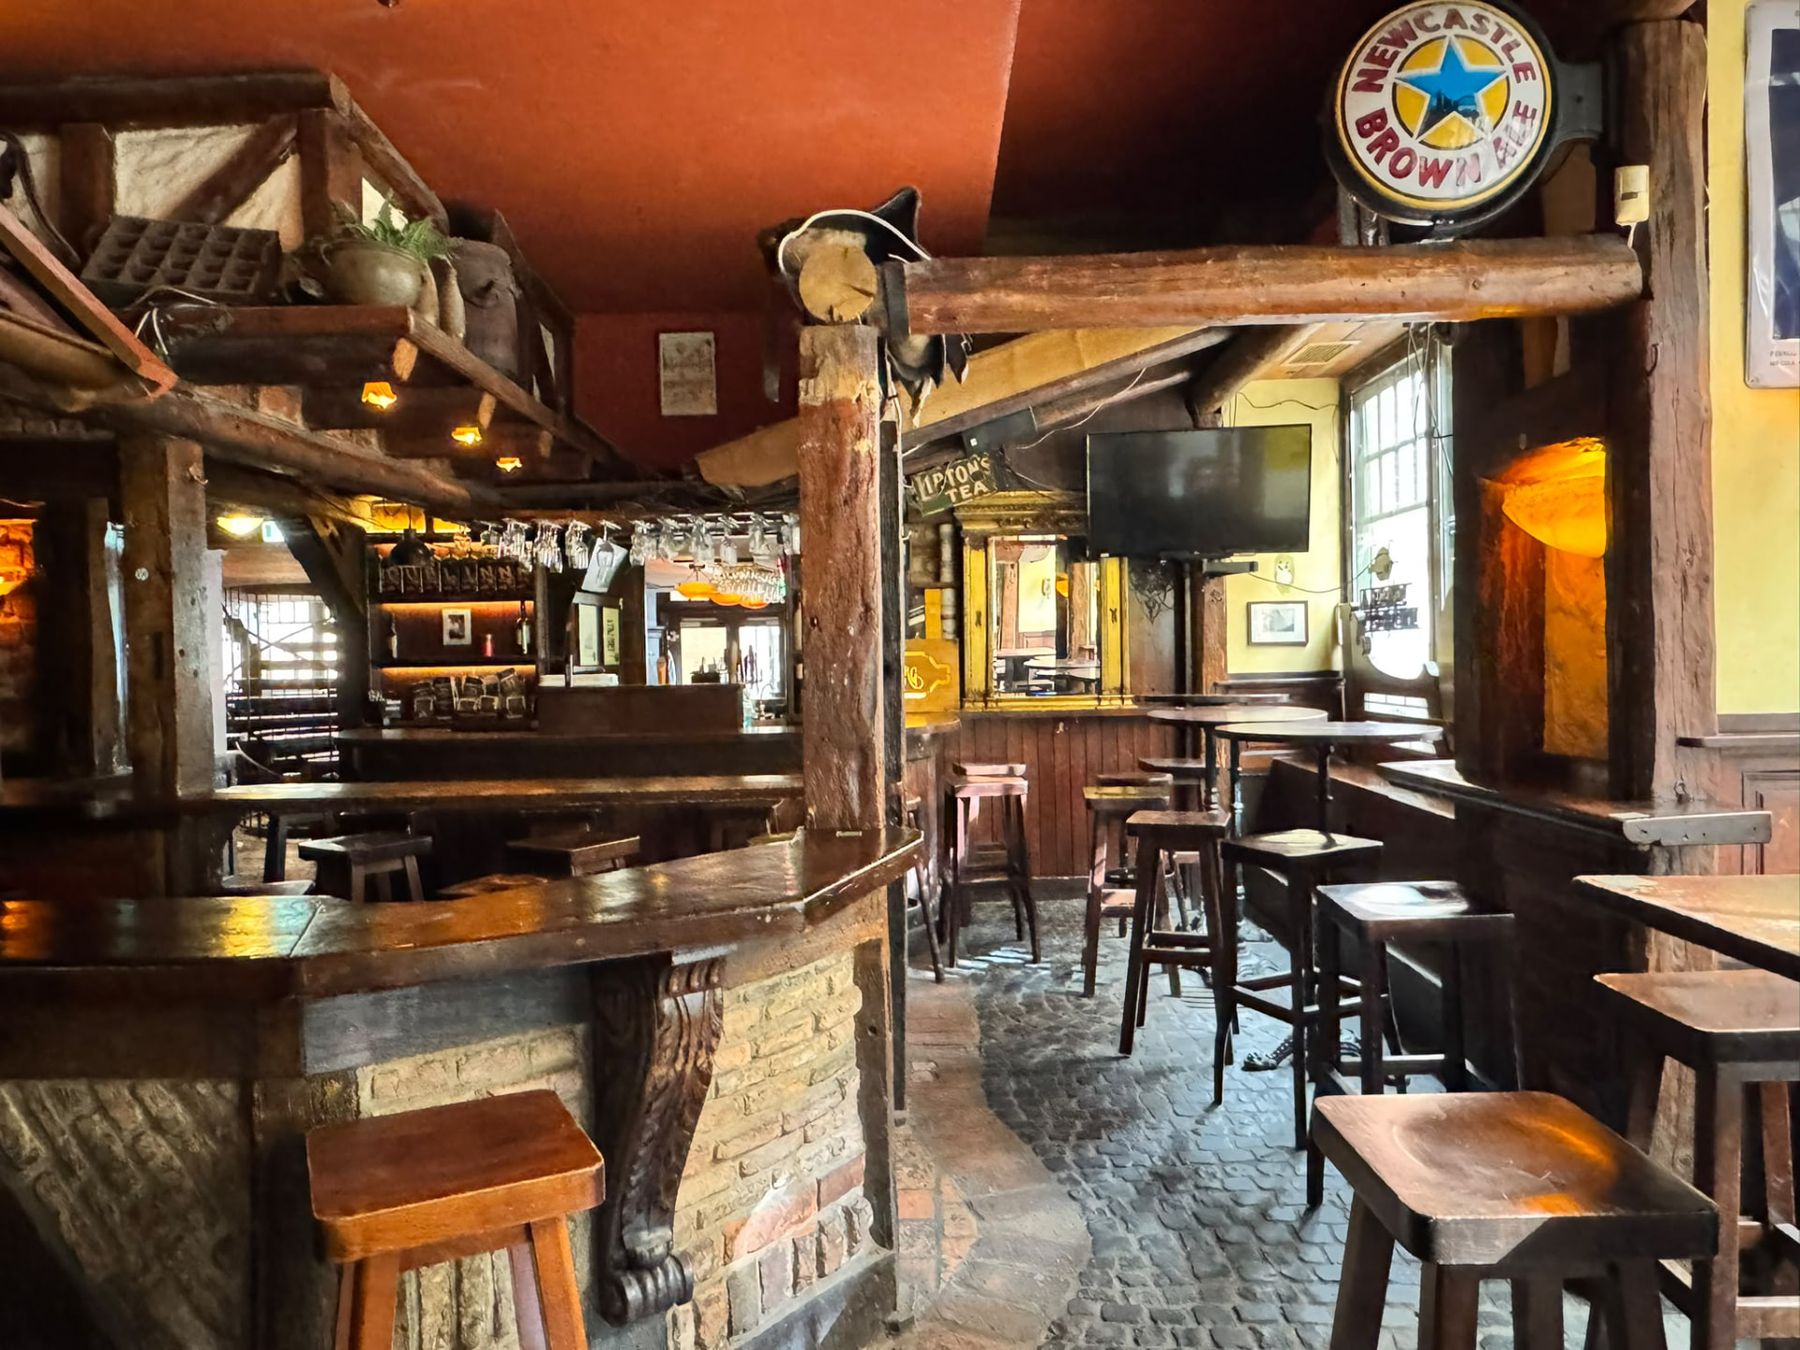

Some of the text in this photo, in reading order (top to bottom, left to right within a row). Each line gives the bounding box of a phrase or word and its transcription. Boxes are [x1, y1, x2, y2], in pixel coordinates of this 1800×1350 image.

[1351, 8, 1537, 93] NEWCASTLE
[1355, 100, 1537, 189] BROWN ALE
[944, 480, 990, 503] TEA
